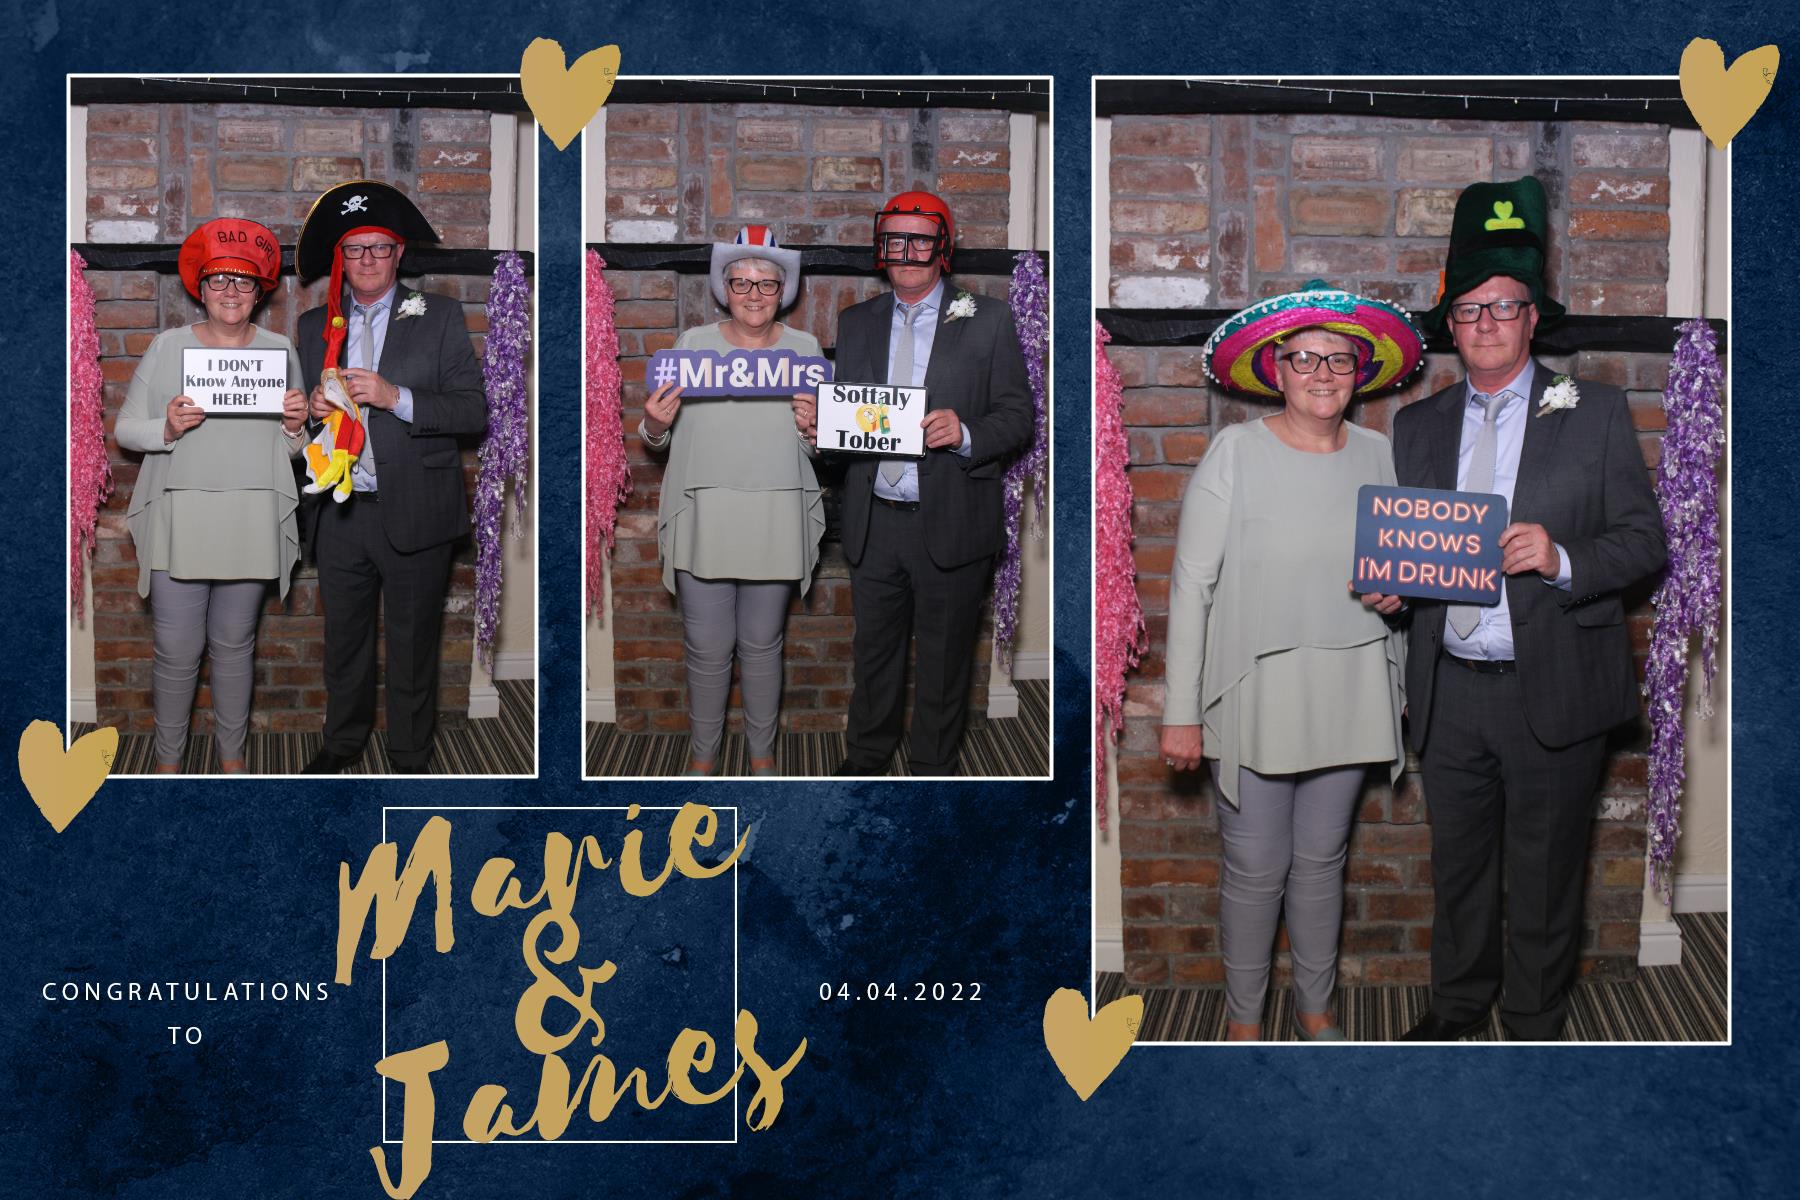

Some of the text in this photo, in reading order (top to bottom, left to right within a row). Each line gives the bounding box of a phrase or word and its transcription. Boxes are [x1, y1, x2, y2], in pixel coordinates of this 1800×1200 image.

[217, 231, 275, 262] BAD GIRL
[207, 359, 264, 372] I DON'T
[654, 357, 825, 388] #Mr&Mrs
[185, 374, 285, 390] Know Anyone
[212, 393, 257, 405] HERE!
[832, 384, 911, 411] Sottaly
[835, 429, 902, 451] Tober
[1372, 496, 1489, 524] NOBODY
[1378, 528, 1481, 555] KNOWS
[1358, 556, 1497, 593] I'M DRUNK
